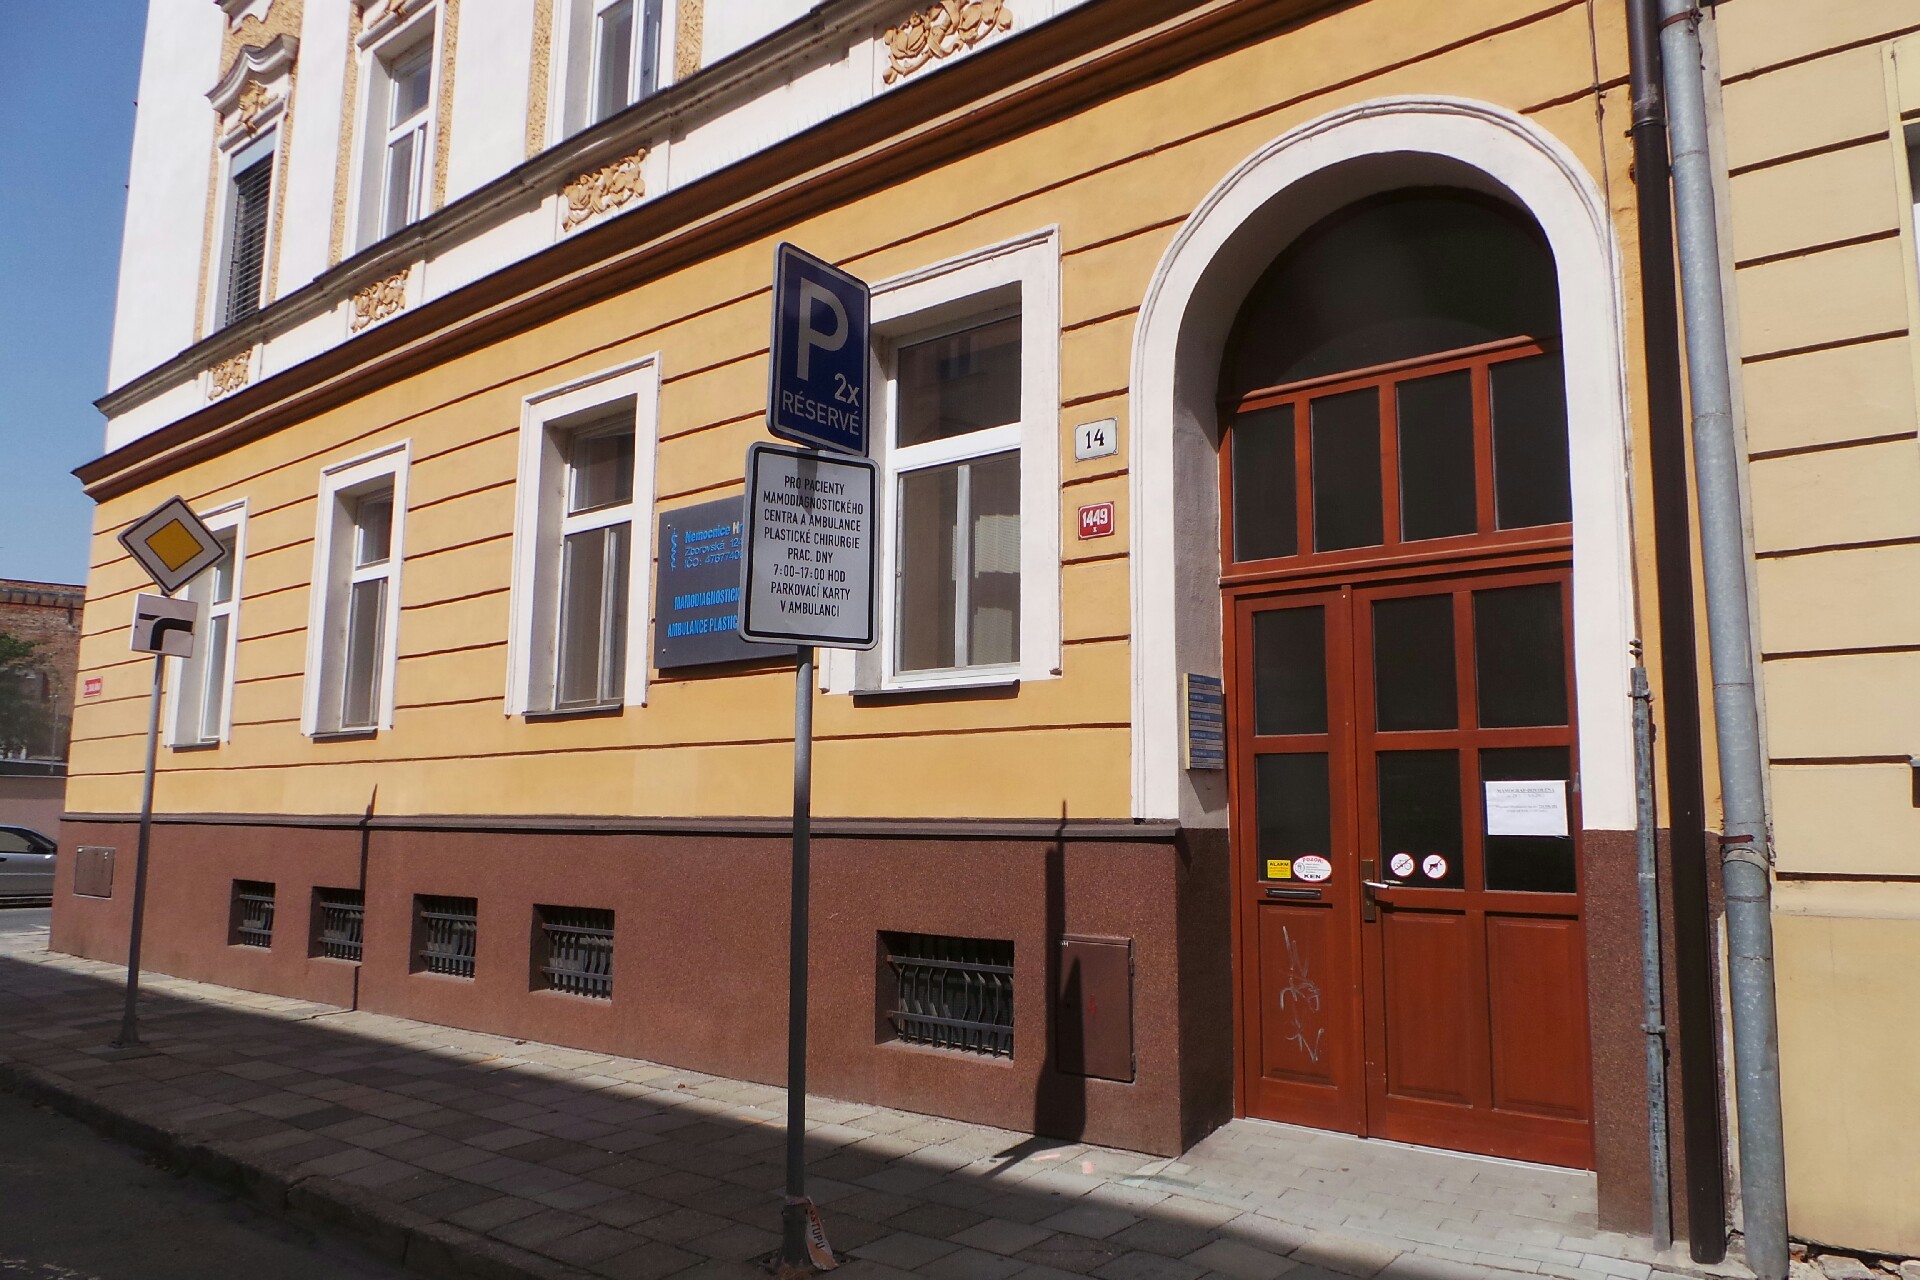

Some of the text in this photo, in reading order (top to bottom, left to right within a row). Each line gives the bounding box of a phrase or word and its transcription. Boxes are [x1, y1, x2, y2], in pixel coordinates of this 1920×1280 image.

[796, 277, 849, 382] P
[782, 390, 860, 436] RÉSERVÉ
[1085, 428, 1105, 449] 14
[784, 475, 845, 496] PRO PACIENTY
[763, 490, 864, 515] MAMODIAGNOSTICKÉHO
[764, 508, 861, 532] CENTRA A AMBULANCE
[1082, 508, 1108, 528] 1449
[685, 524, 731, 543] Nemocnice
[764, 526, 860, 549] PLASTICKÉ CHIRURGIE
[685, 540, 725, 557] Zborovská
[787, 547, 833, 563] PRAC. DNY
[773, 564, 845, 582] 7:00-17:00 HOD
[770, 581, 850, 601] PARKOVACÍ KARTY
[780, 600, 840, 617] V AMBULANCI
[667, 619, 708, 638] AMBULANCE
